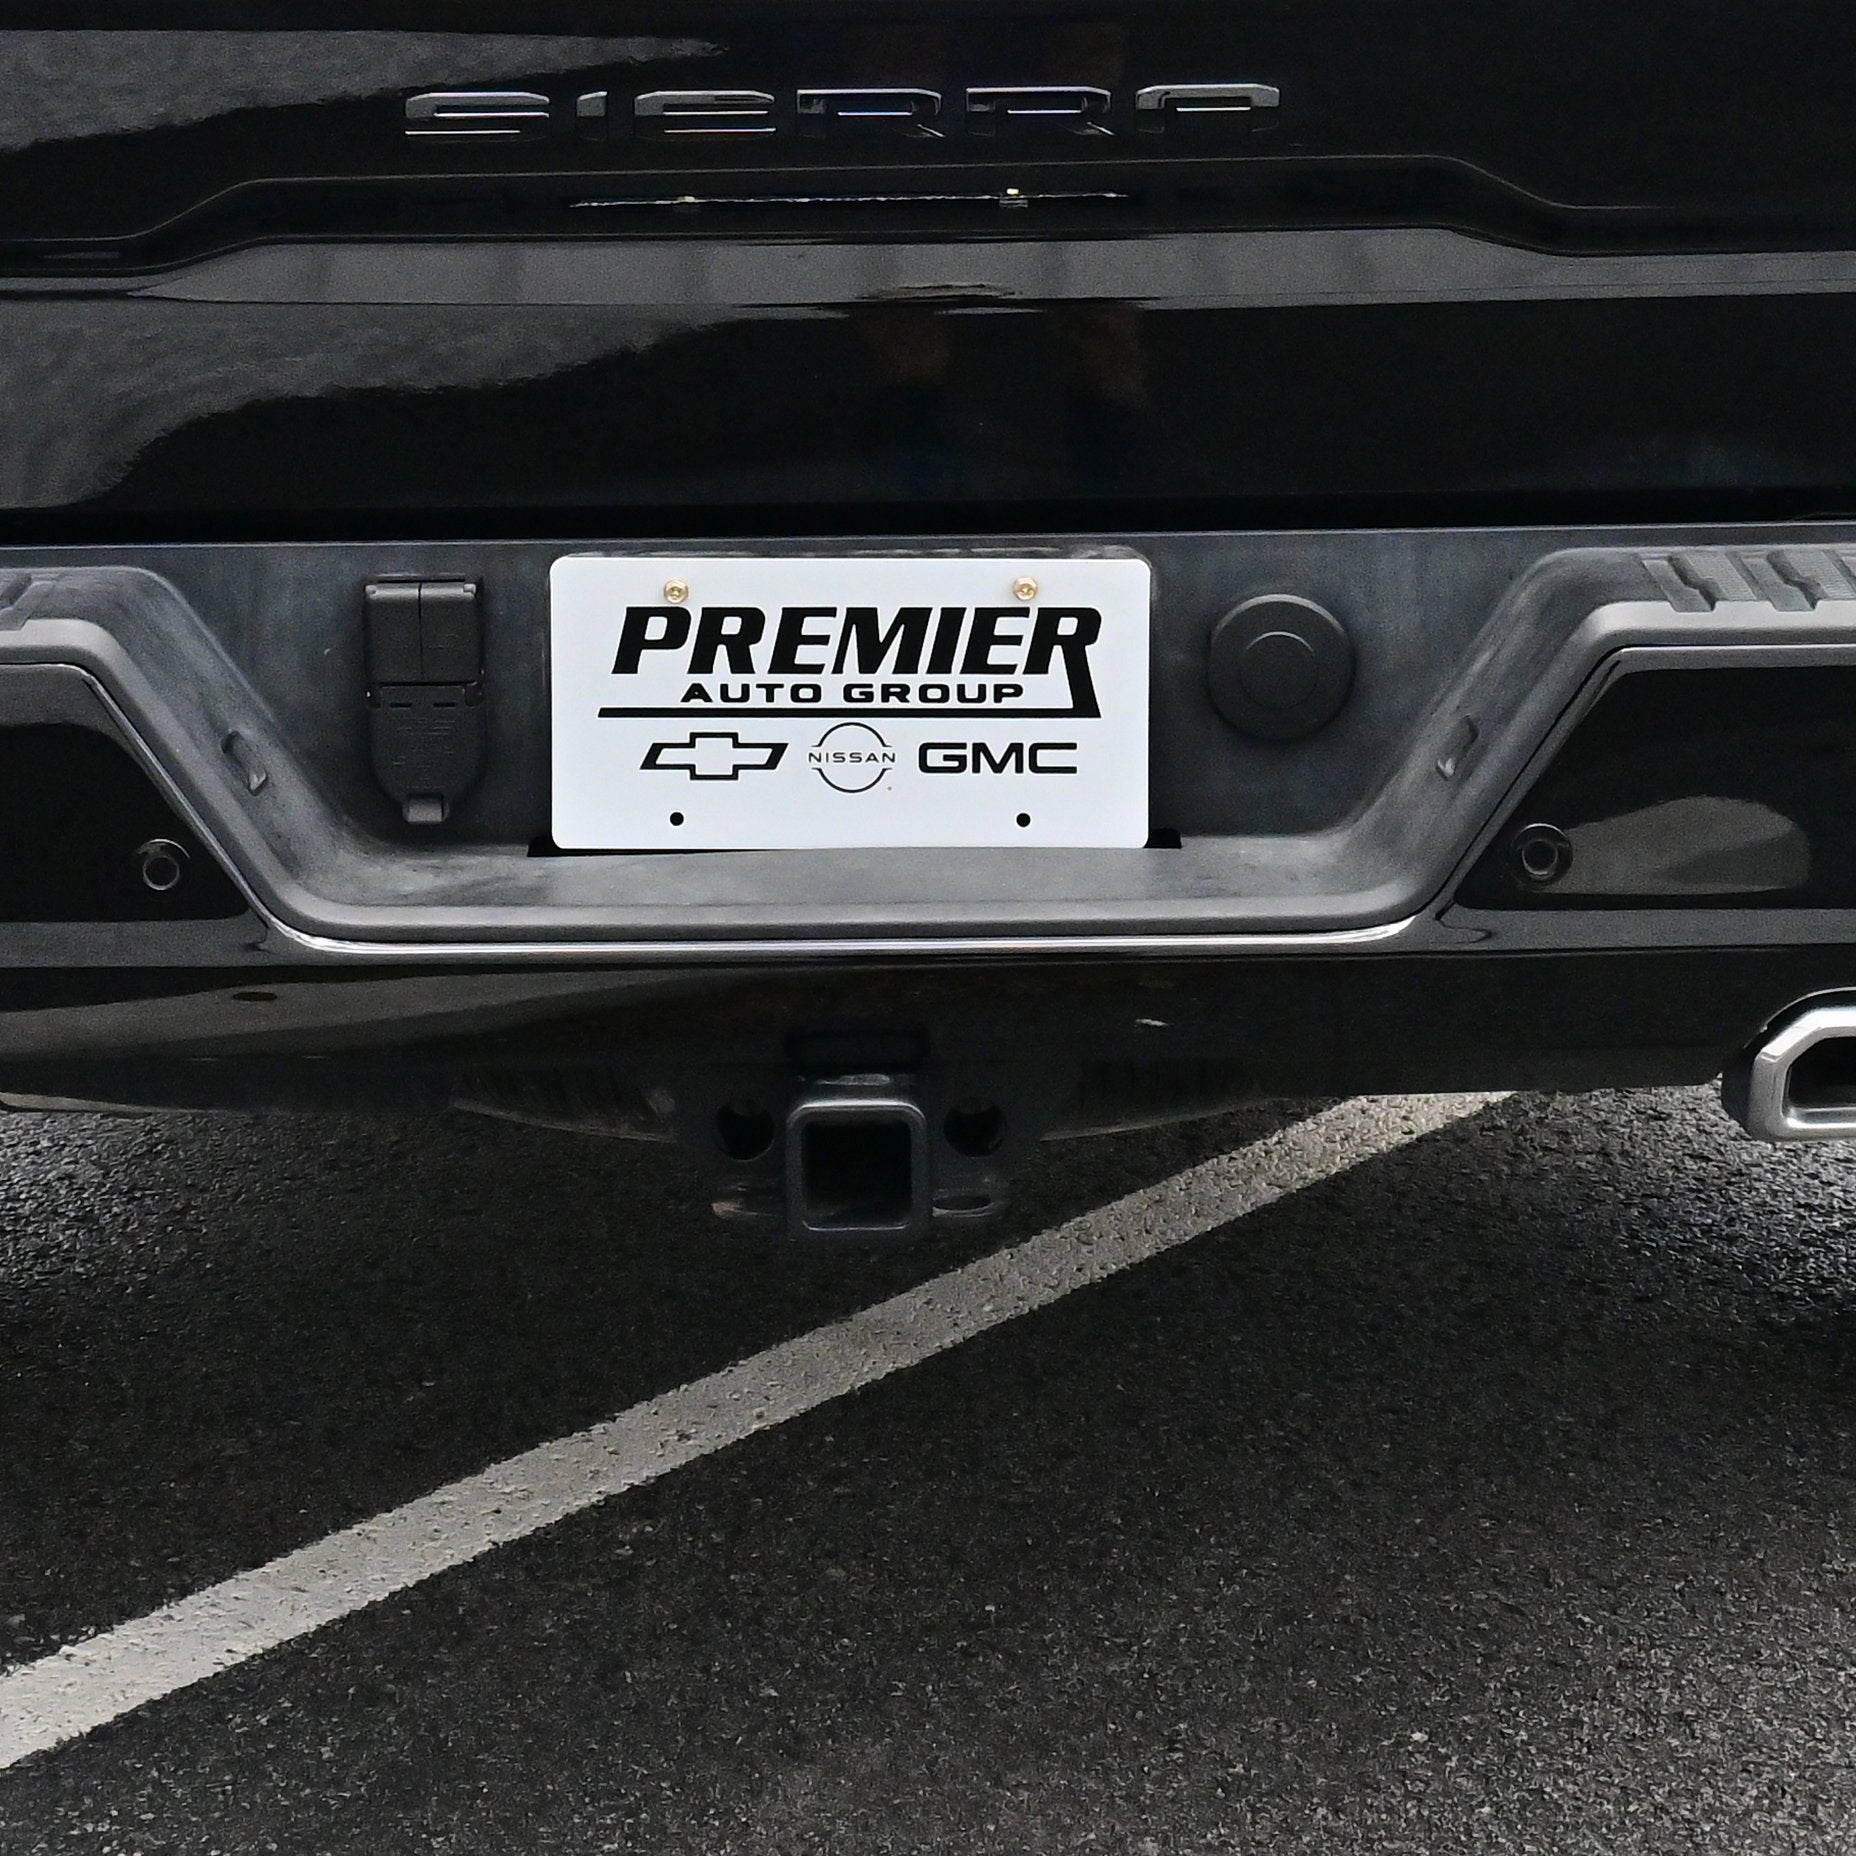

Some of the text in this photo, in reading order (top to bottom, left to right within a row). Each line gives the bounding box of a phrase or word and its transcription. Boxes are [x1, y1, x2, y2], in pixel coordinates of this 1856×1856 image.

[405, 82, 1281, 142] SIERRA
[610, 605, 1103, 686] PREMIER
[679, 682, 1026, 704] AUTO GROUP
[808, 752, 896, 763] NISSAN
[917, 742, 1078, 774] GMC
